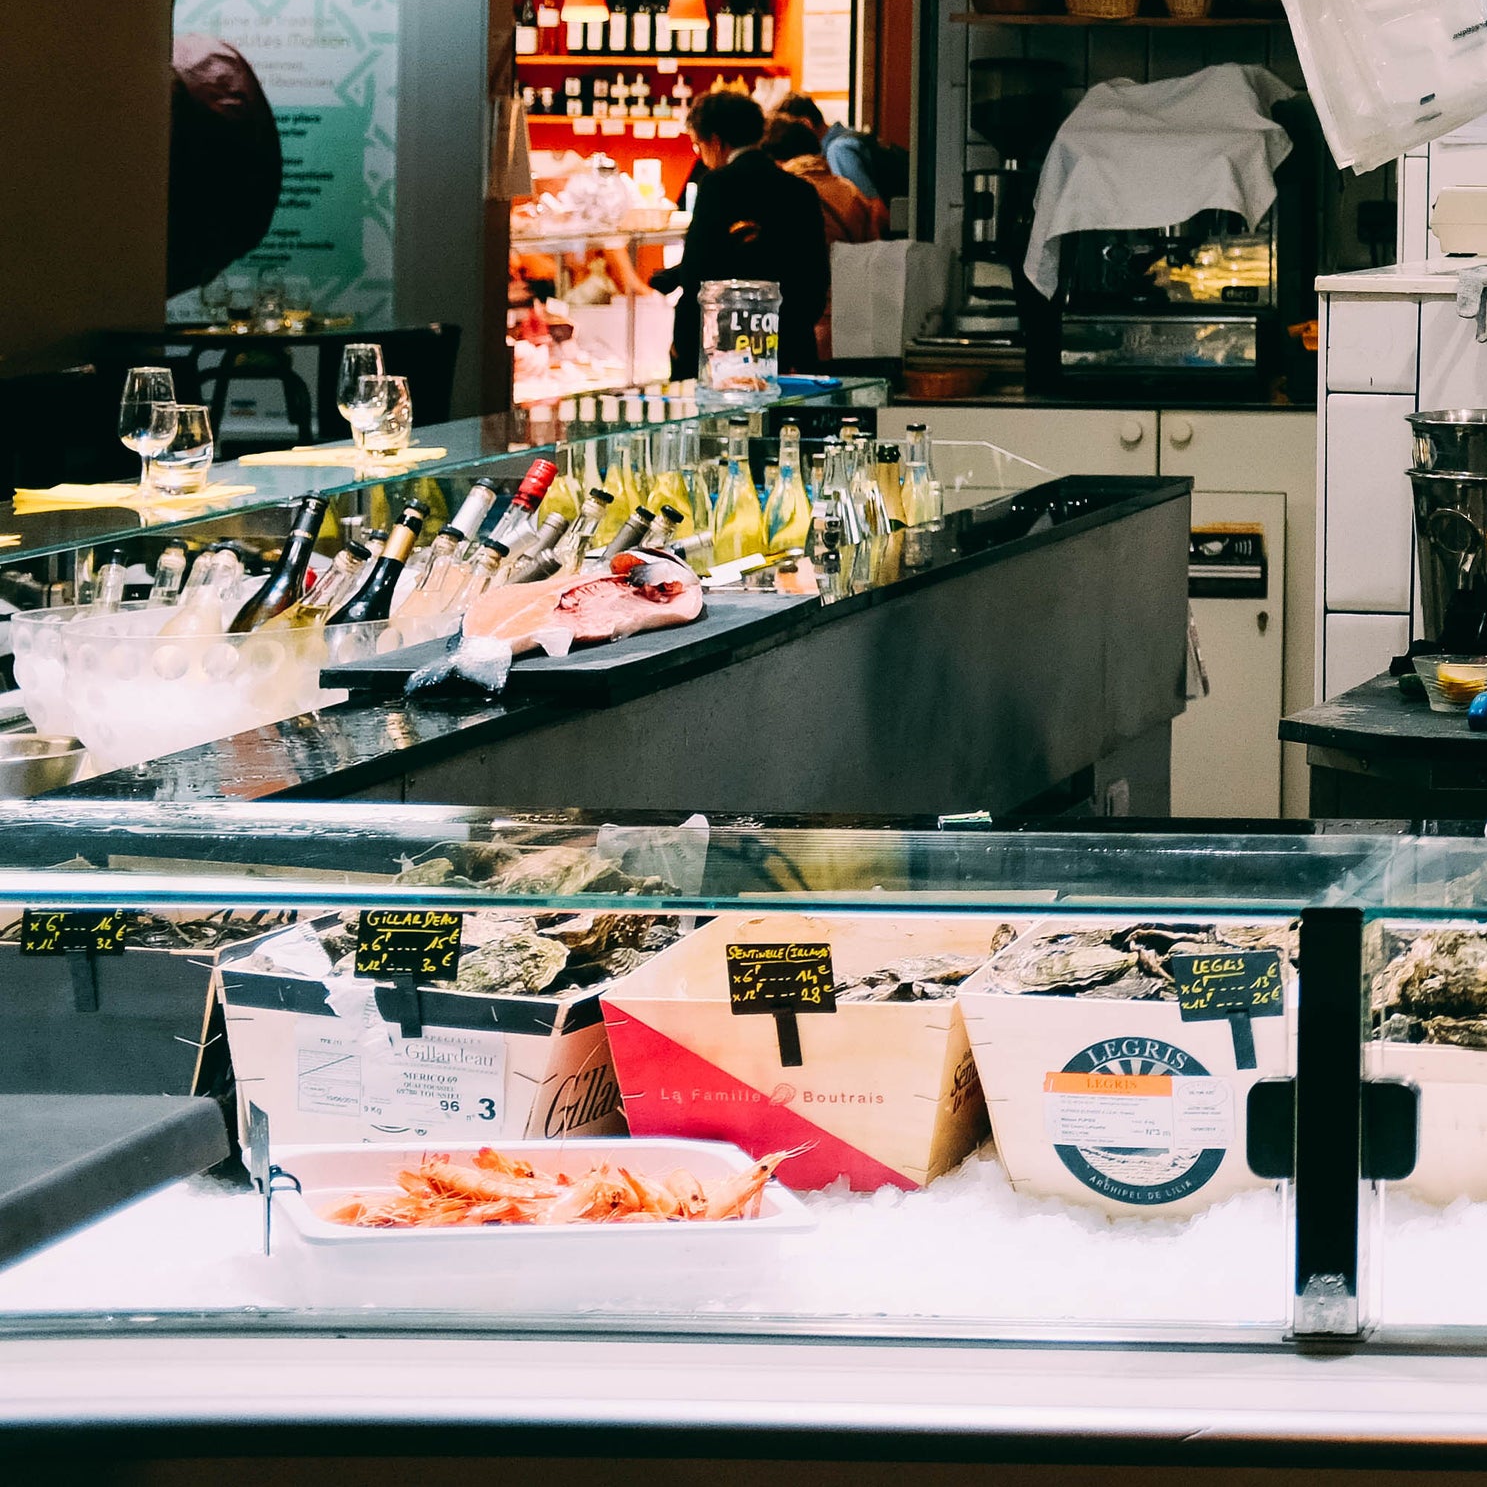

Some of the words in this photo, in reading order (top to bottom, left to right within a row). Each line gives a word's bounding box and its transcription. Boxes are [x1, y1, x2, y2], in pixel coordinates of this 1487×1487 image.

[405, 1042, 497, 1067] Gillardeau
[1086, 1038, 1189, 1071] LEGRIS
[1086, 1077, 1139, 1091] LEGRIS
[692, 1087, 762, 1104] Famille
[802, 1090, 885, 1105] Boutrais
[439, 1099, 460, 1113] 96
[477, 1097, 497, 1121] 3
[1146, 1191, 1162, 1200] DE
